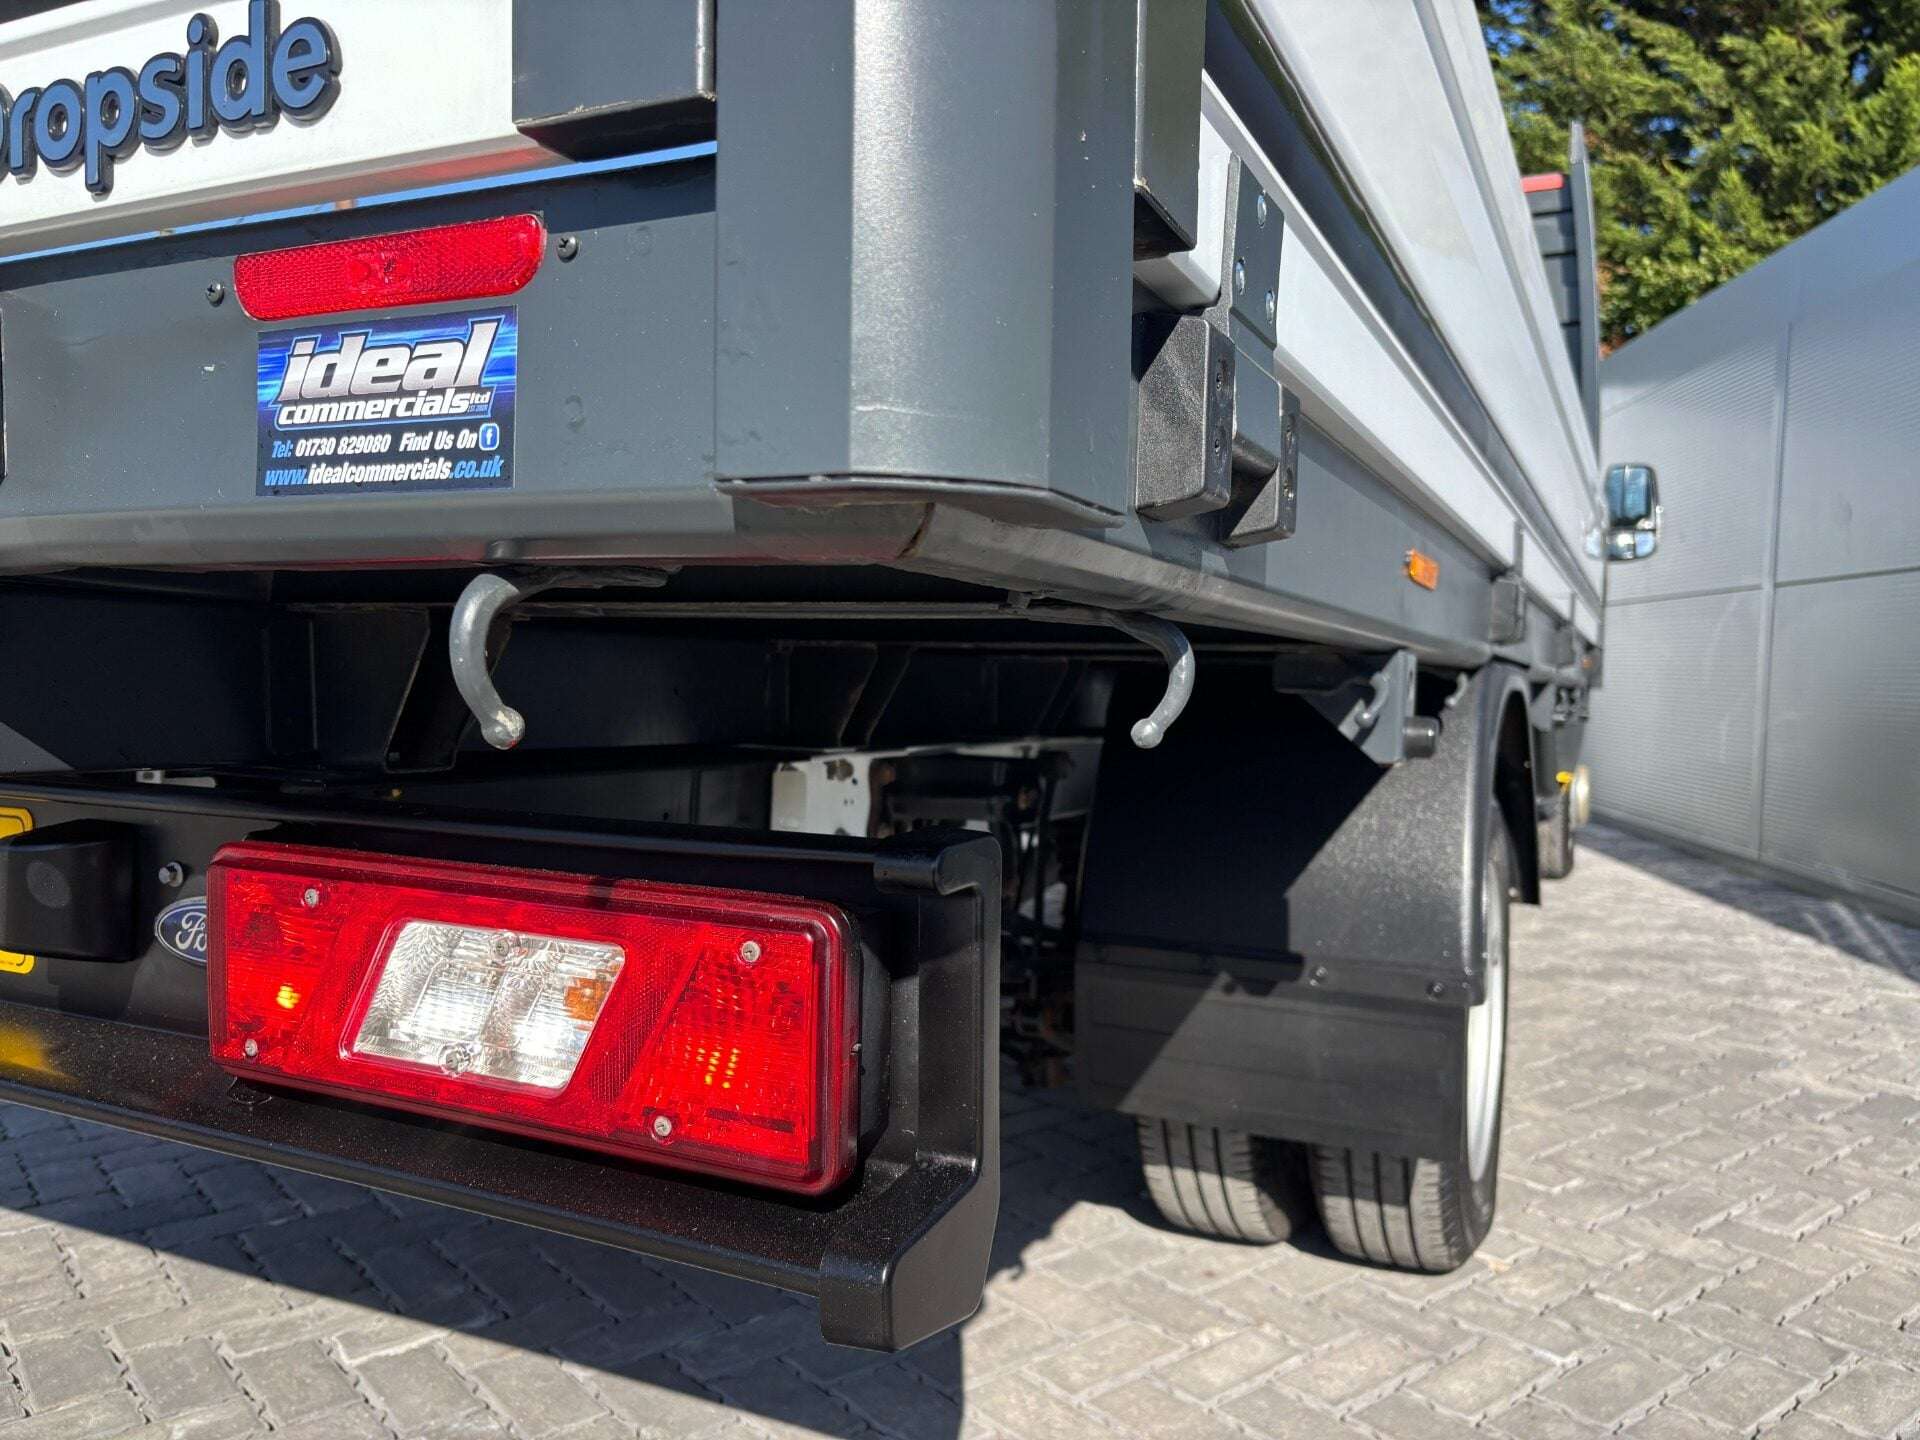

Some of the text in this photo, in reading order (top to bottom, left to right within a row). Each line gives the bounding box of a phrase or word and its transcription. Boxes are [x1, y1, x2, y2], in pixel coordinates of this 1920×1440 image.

[0, 0, 342, 196] ropside
[277, 320, 501, 402] ideal
[277, 388, 491, 425] commercials ltd
[271, 440, 294, 458] Tel:
[295, 438, 336, 457] 01730
[337, 434, 392, 455] 829080
[399, 431, 434, 452] Find
[434, 430, 454, 450] Us
[456, 429, 478, 449] On
[264, 455, 504, 486] www.idealcommercials.co.uk
[175, 911, 208, 952] Fo
